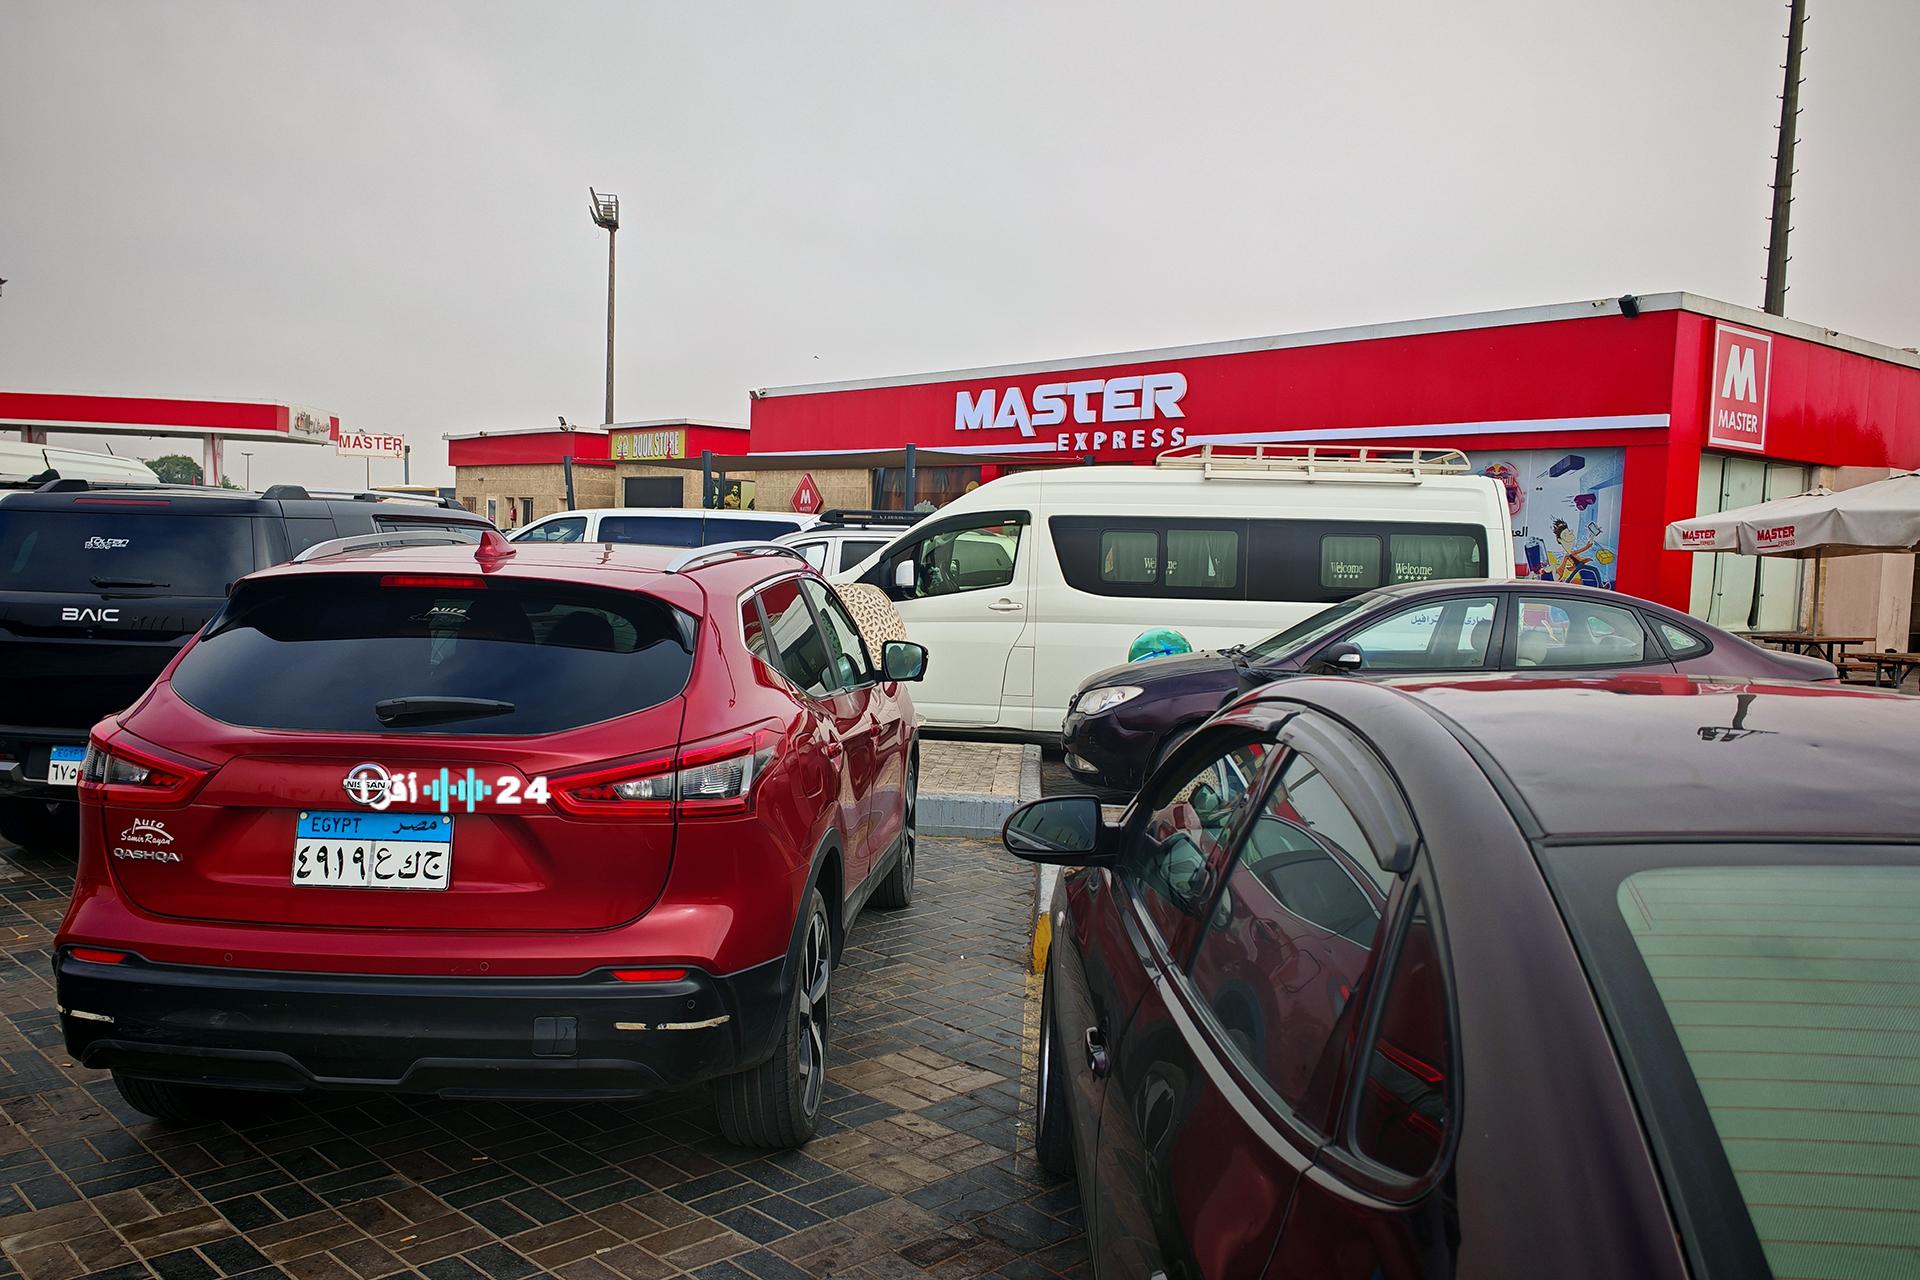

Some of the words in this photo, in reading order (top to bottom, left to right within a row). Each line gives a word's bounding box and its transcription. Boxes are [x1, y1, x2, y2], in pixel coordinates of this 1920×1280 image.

[1721, 344, 1757, 403] M
[954, 372, 1188, 437] MASTER
[1718, 409, 1757, 433] MASTER
[339, 434, 402, 451] MASTER
[632, 433, 654, 457] BOOK
[654, 431, 679, 456] STORE
[1057, 427, 1185, 451] EXPRESS
[800, 489, 811, 504] M
[1682, 530, 1716, 542] MASTER
[1757, 526, 1795, 542] MASTER
[1331, 561, 1363, 574] Welcome
[1395, 562, 1433, 575] Welcome
[62, 607, 120, 622] BAIC
[312, 817, 362, 833] EGYPT
[392, 822, 437, 834] مصر
[145, 833, 171, 846] Rayan
